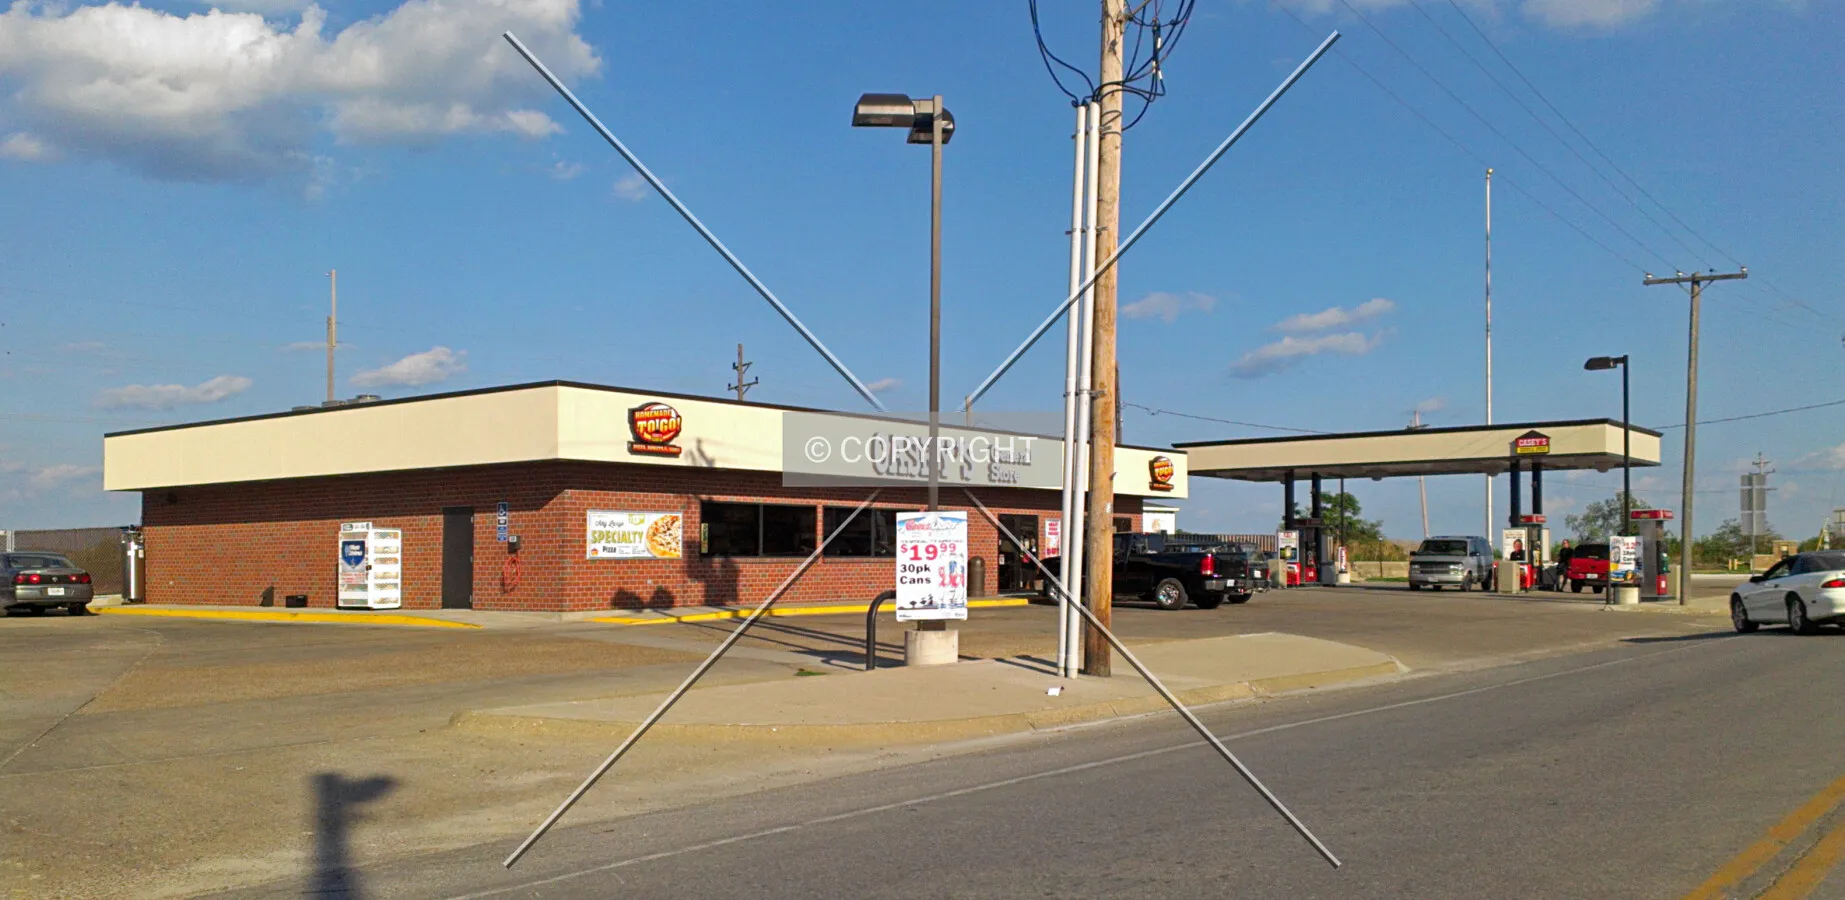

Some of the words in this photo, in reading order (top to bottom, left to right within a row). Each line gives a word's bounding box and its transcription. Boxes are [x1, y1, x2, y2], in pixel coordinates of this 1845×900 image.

[591, 530, 644, 544] SPECIALTY
[900, 564, 931, 574] 30pk
[900, 576, 931, 585] Cans
